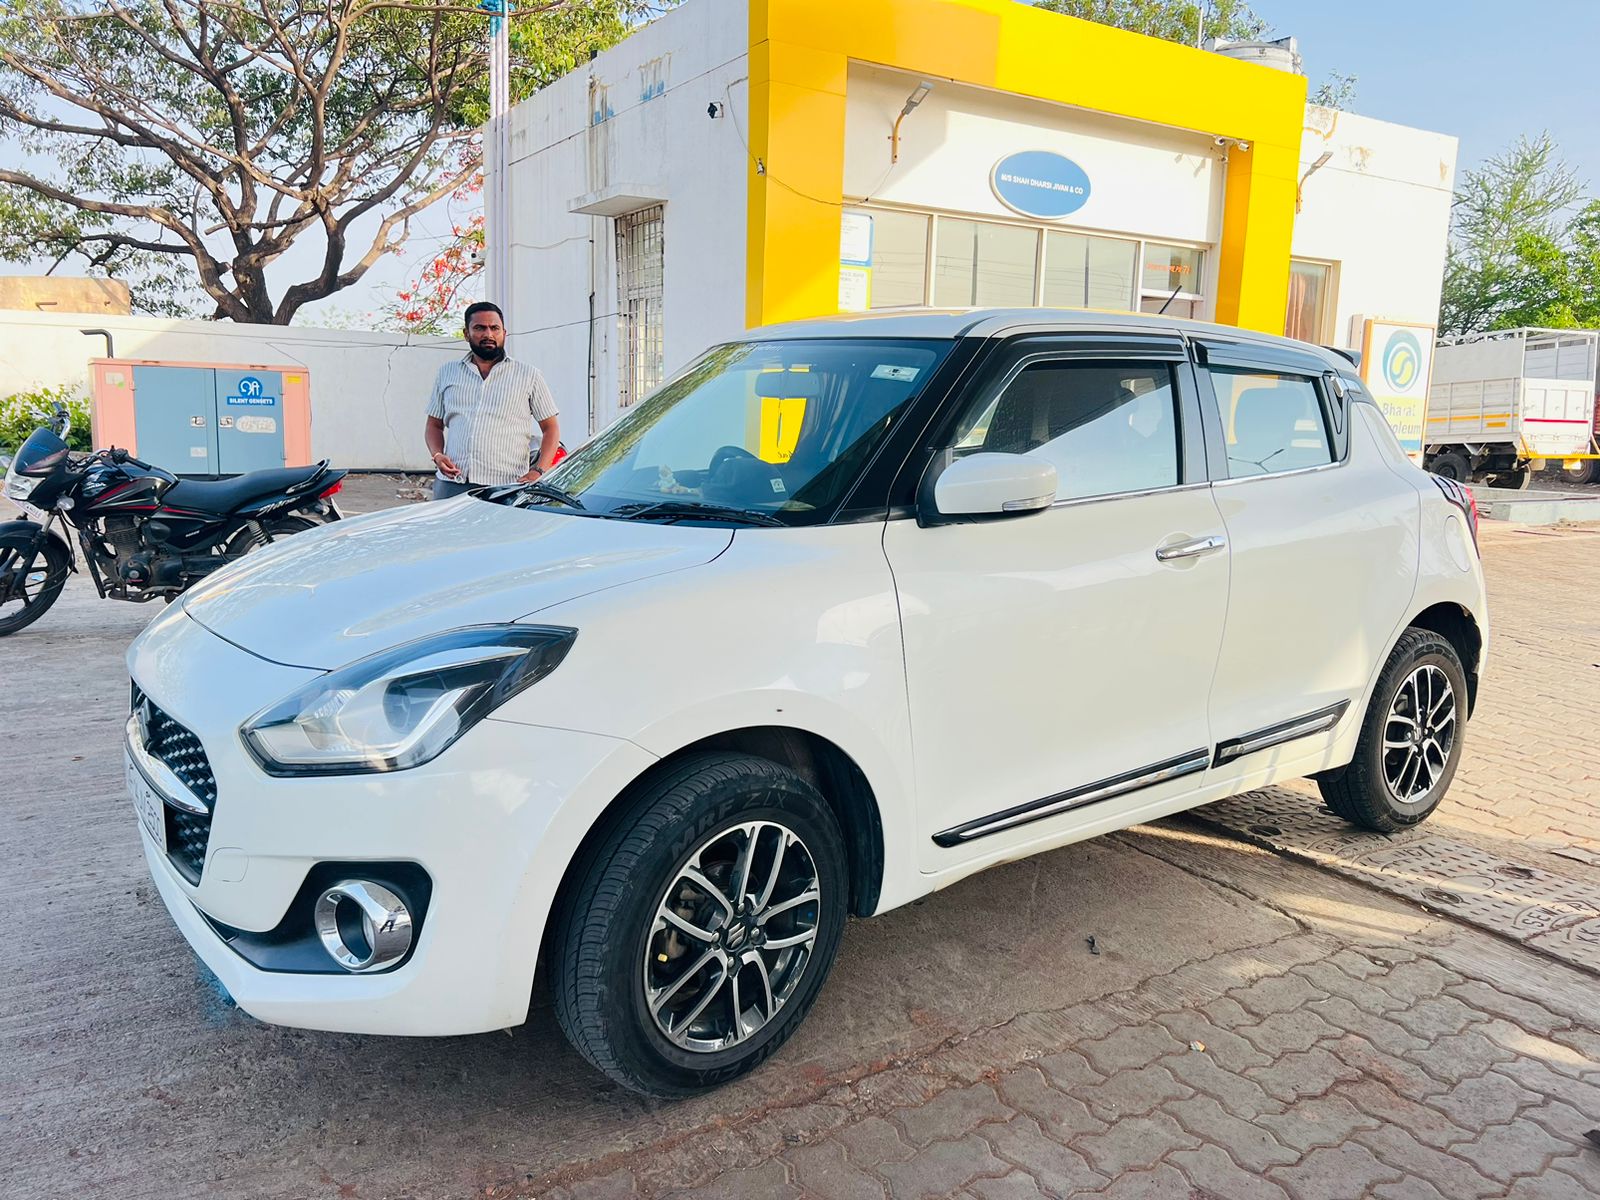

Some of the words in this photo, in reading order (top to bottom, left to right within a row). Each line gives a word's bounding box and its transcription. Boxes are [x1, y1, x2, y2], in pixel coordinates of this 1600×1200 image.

[1013, 175, 1029, 186] SHAH
[1030, 179, 1052, 190] DHARSI
[1053, 183, 1069, 193] JIVAN
[1074, 187, 1083, 195] CO
[671, 798, 735, 863] MRF
[1521, 900, 1590, 928] SEWER
